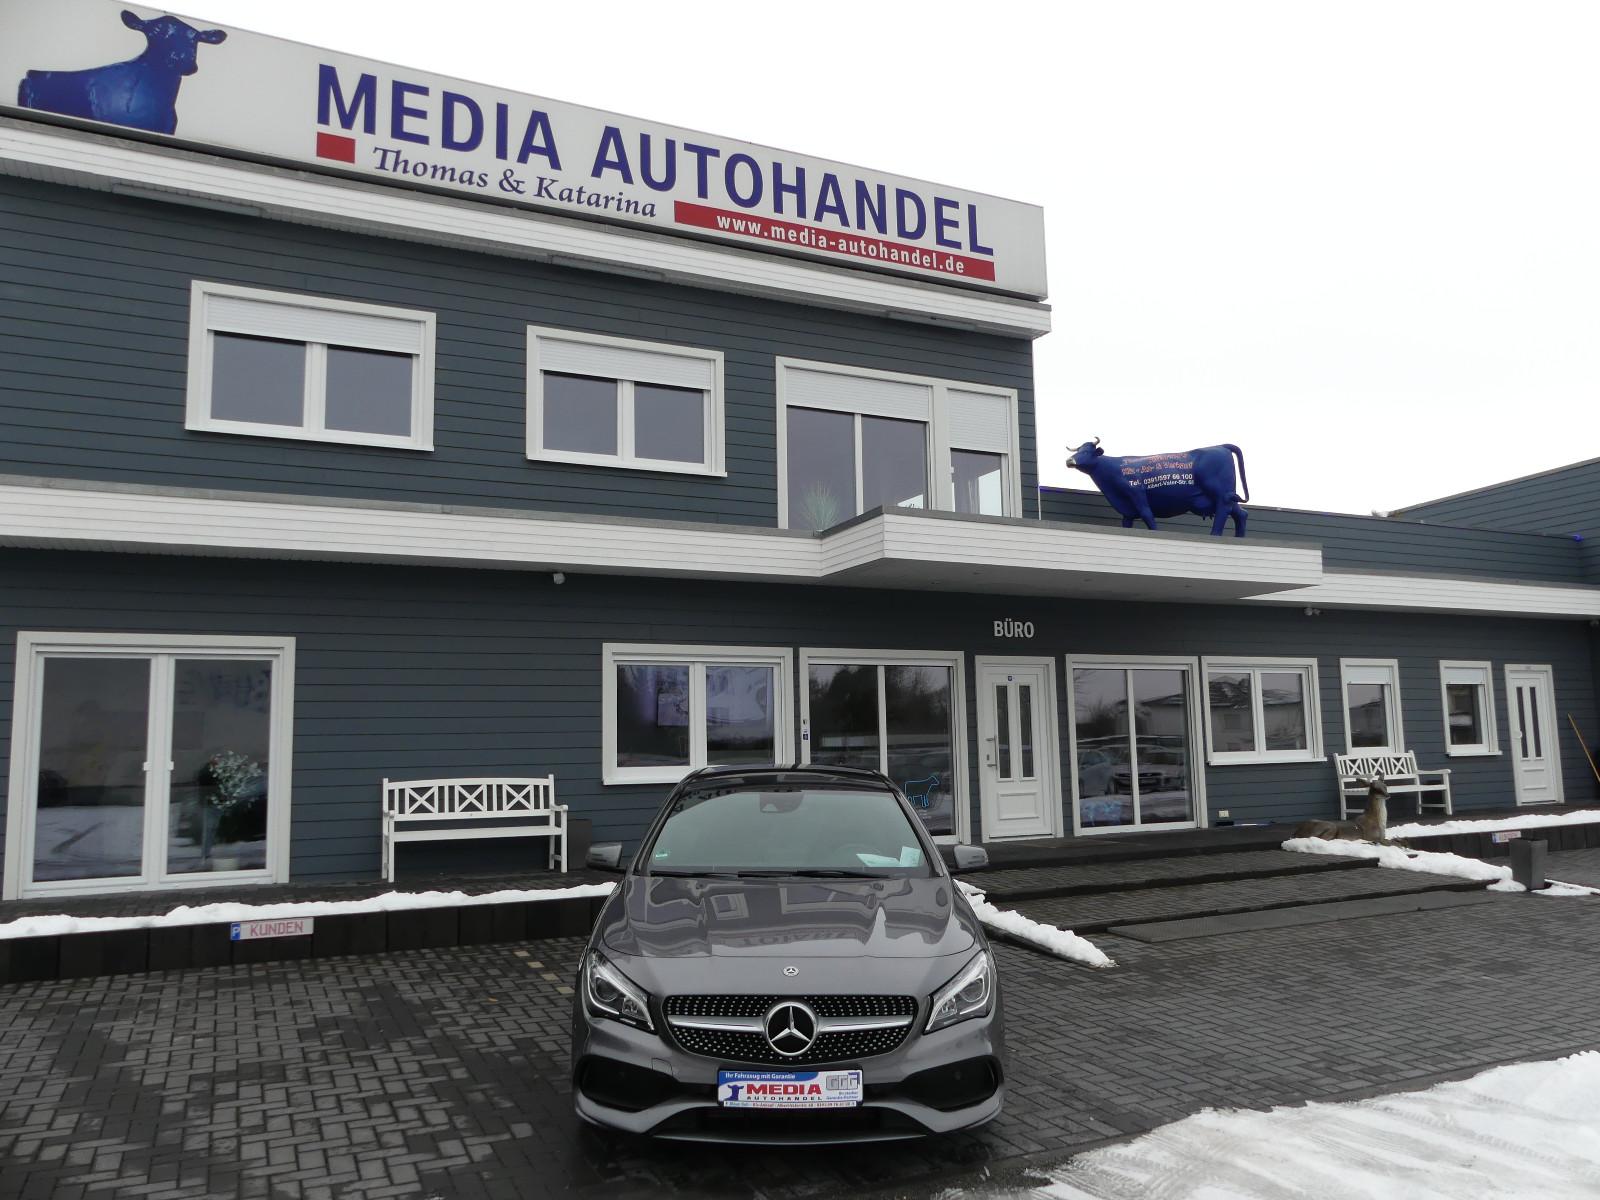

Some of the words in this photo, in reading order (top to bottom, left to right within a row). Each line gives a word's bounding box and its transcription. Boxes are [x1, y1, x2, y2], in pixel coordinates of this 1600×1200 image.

[317, 64, 561, 170] MEDIA
[591, 126, 994, 256] AUTOHANDEL
[373, 146, 488, 188] Thomas
[499, 169, 526, 194] &
[534, 176, 657, 218] Katarina
[717, 215, 965, 273] www.media-autohandel.de
[993, 618, 1035, 638] BÜRO
[232, 926, 240, 937] P
[250, 921, 304, 936] KUNDEN
[746, 1083, 822, 1095] MEDIA
